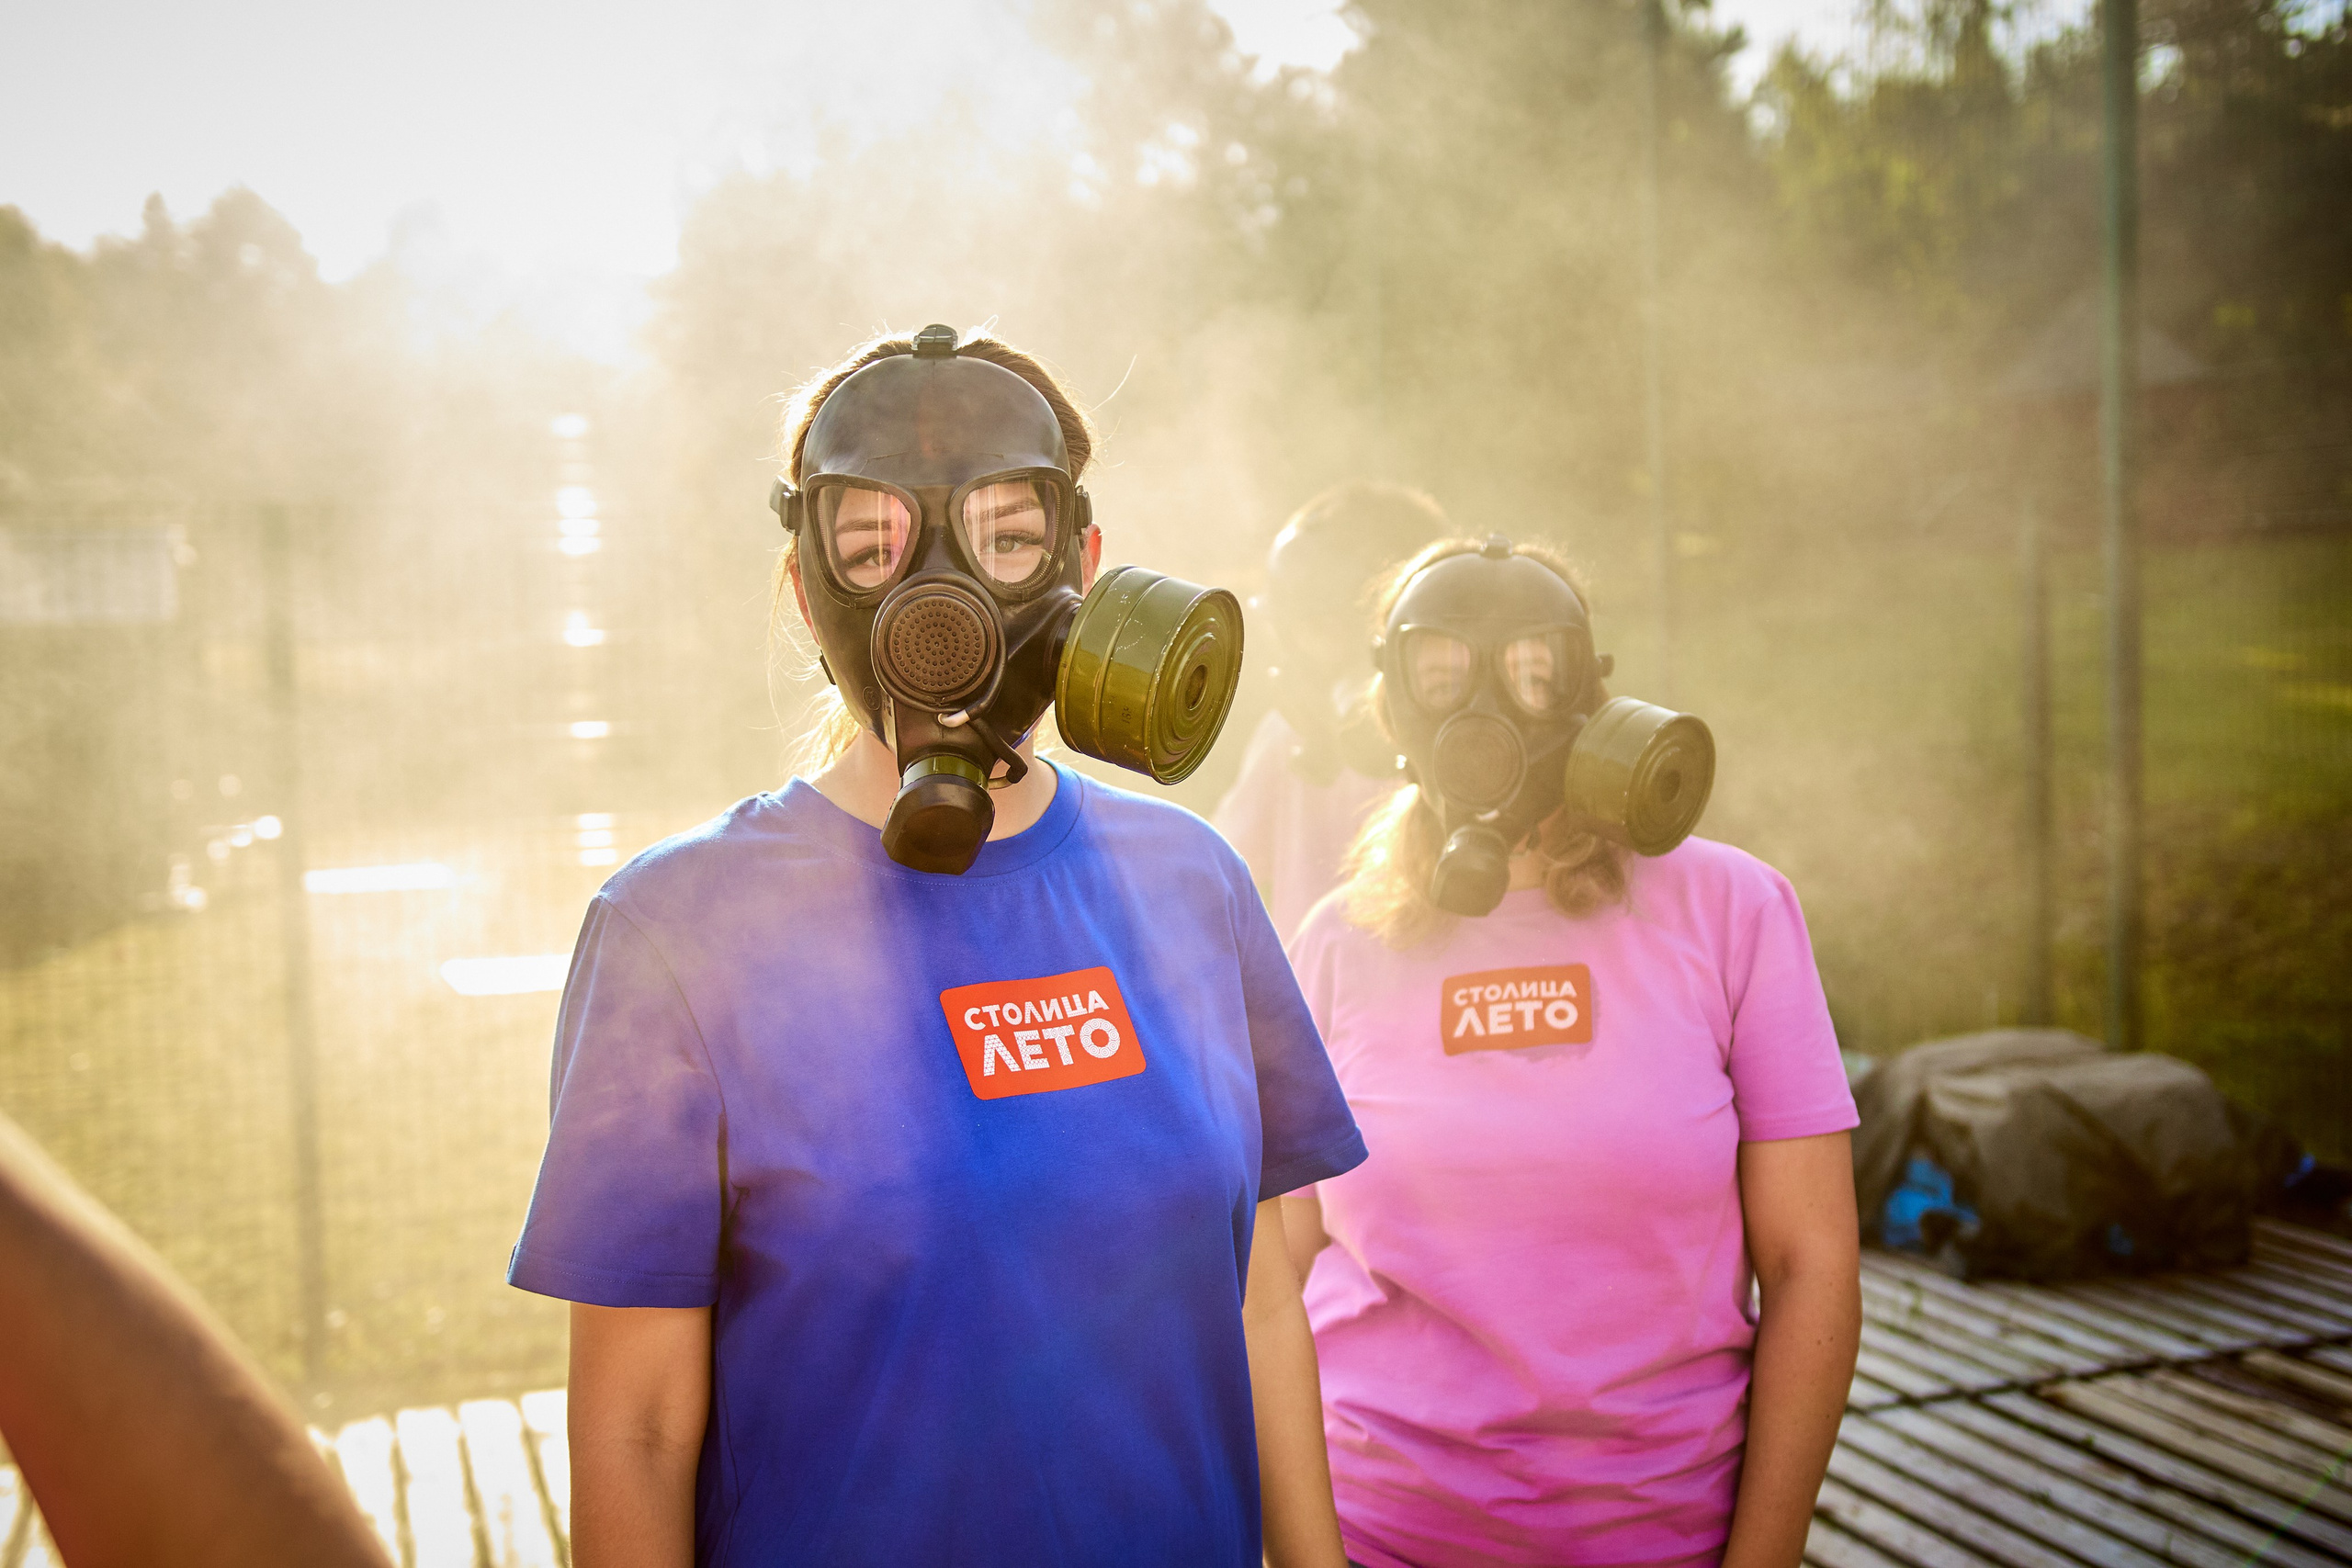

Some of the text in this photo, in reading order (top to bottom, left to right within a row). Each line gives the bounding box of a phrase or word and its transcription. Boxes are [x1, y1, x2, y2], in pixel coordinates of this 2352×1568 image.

[964, 989, 1110, 1031] СТОЛИЦА
[1453, 980, 1577, 1007] СТОЛИЦА
[1453, 998, 1578, 1038] ЛЕТО
[983, 1017, 1121, 1077] ЛЕТО
